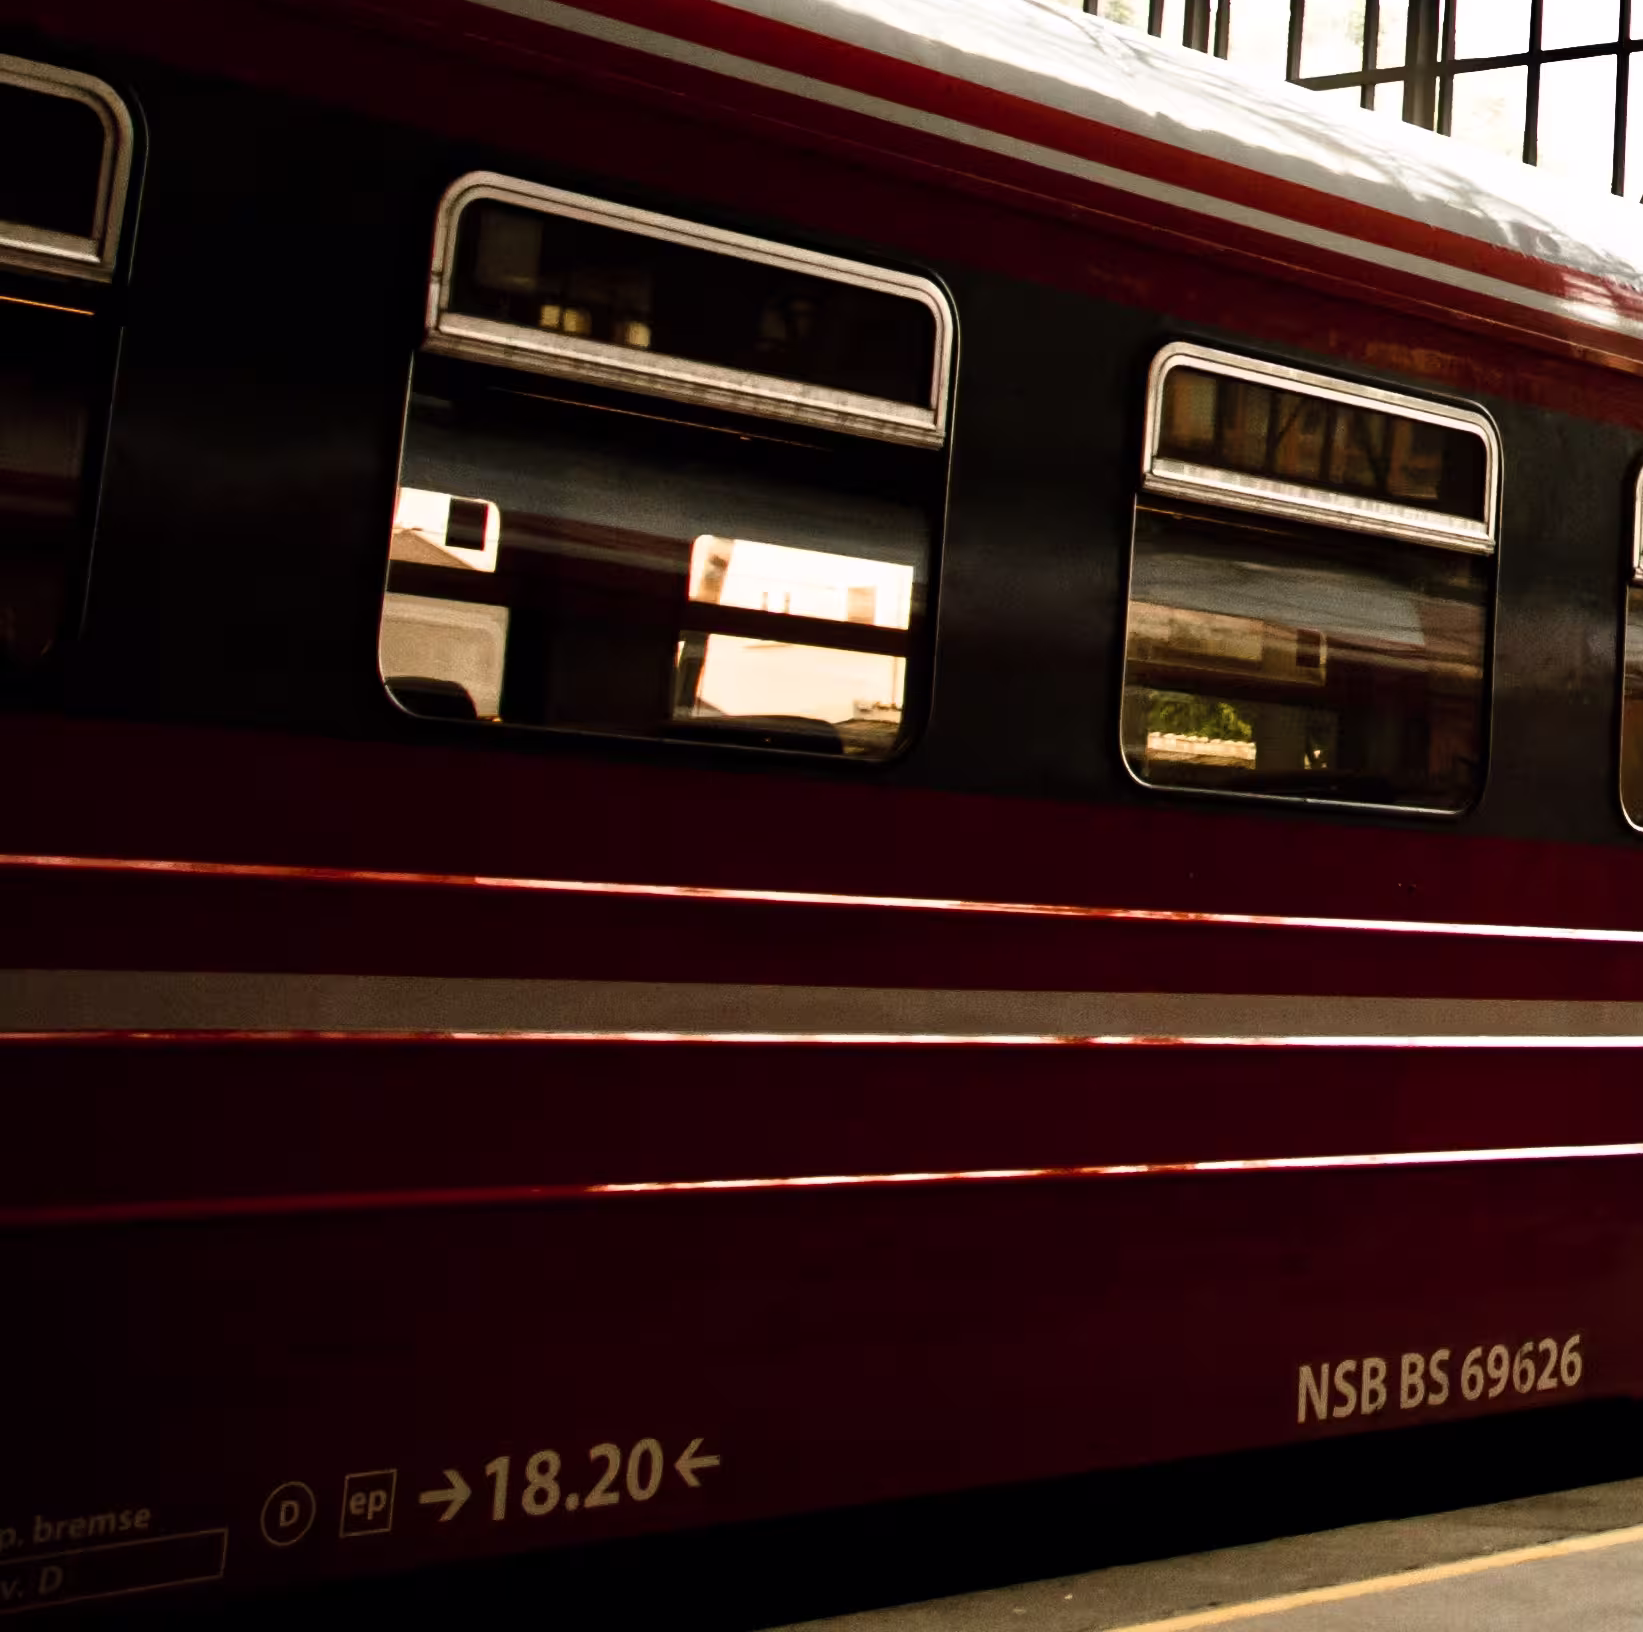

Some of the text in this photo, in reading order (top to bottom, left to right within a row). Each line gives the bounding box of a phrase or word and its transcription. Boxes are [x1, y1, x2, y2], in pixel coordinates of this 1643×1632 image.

[1298, 1334, 1582, 1424] NSB BS 69626
[485, 1437, 664, 1521] 18.20
[279, 1499, 300, 1527] D
[349, 1489, 387, 1520] ep
[33, 1508, 151, 1544] bremse
[37, 1565, 64, 1595] D
